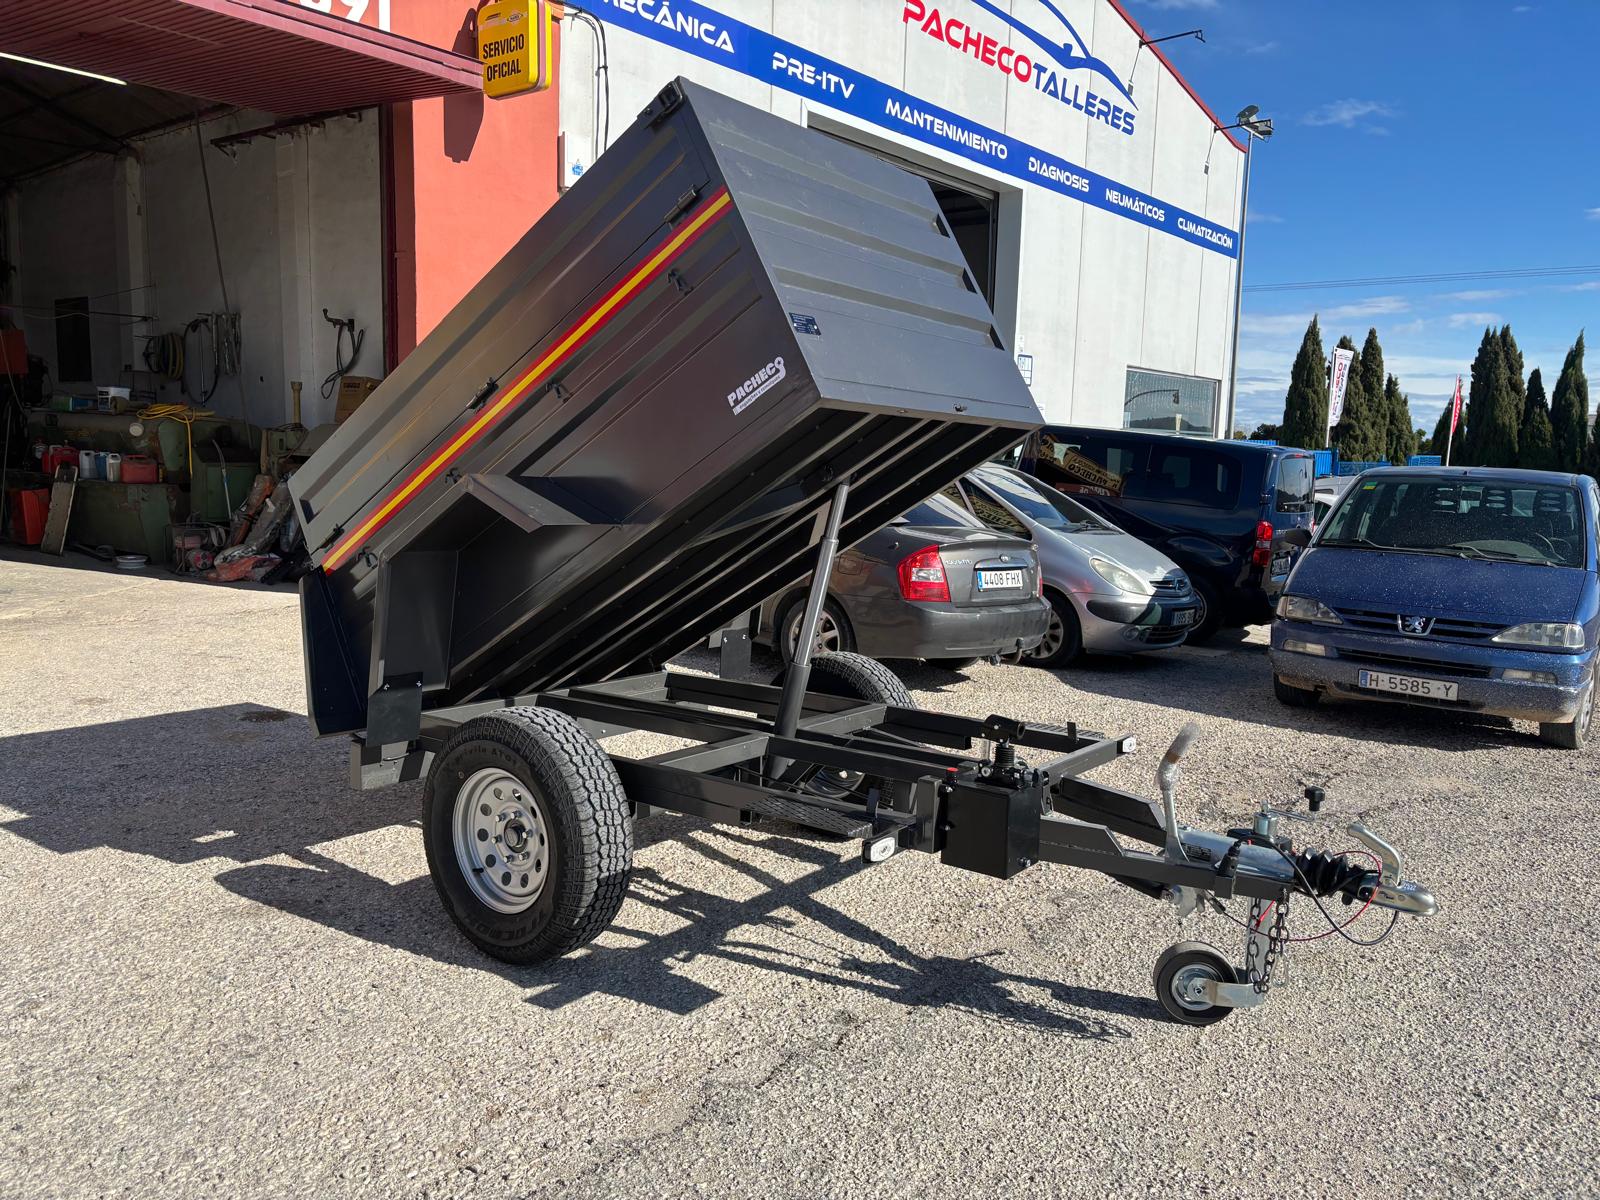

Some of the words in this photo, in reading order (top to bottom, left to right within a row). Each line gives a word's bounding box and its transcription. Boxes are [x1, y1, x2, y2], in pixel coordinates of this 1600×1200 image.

[482, 33, 525, 60] SERVICIO
[486, 58, 522, 82] OFICIAL
[772, 52, 855, 99] PRE-ITV
[885, 98, 1008, 160] MANTENIMIENTO
[1028, 156, 1090, 193] DIAGNOSIS
[1105, 188, 1165, 222] NEUMÁTICOS
[1177, 217, 1233, 249] CLIMATIZACIÓN
[727, 357, 785, 407] PACHECO
[984, 571, 1004, 586] 4408
[1005, 571, 1021, 586] FHX
